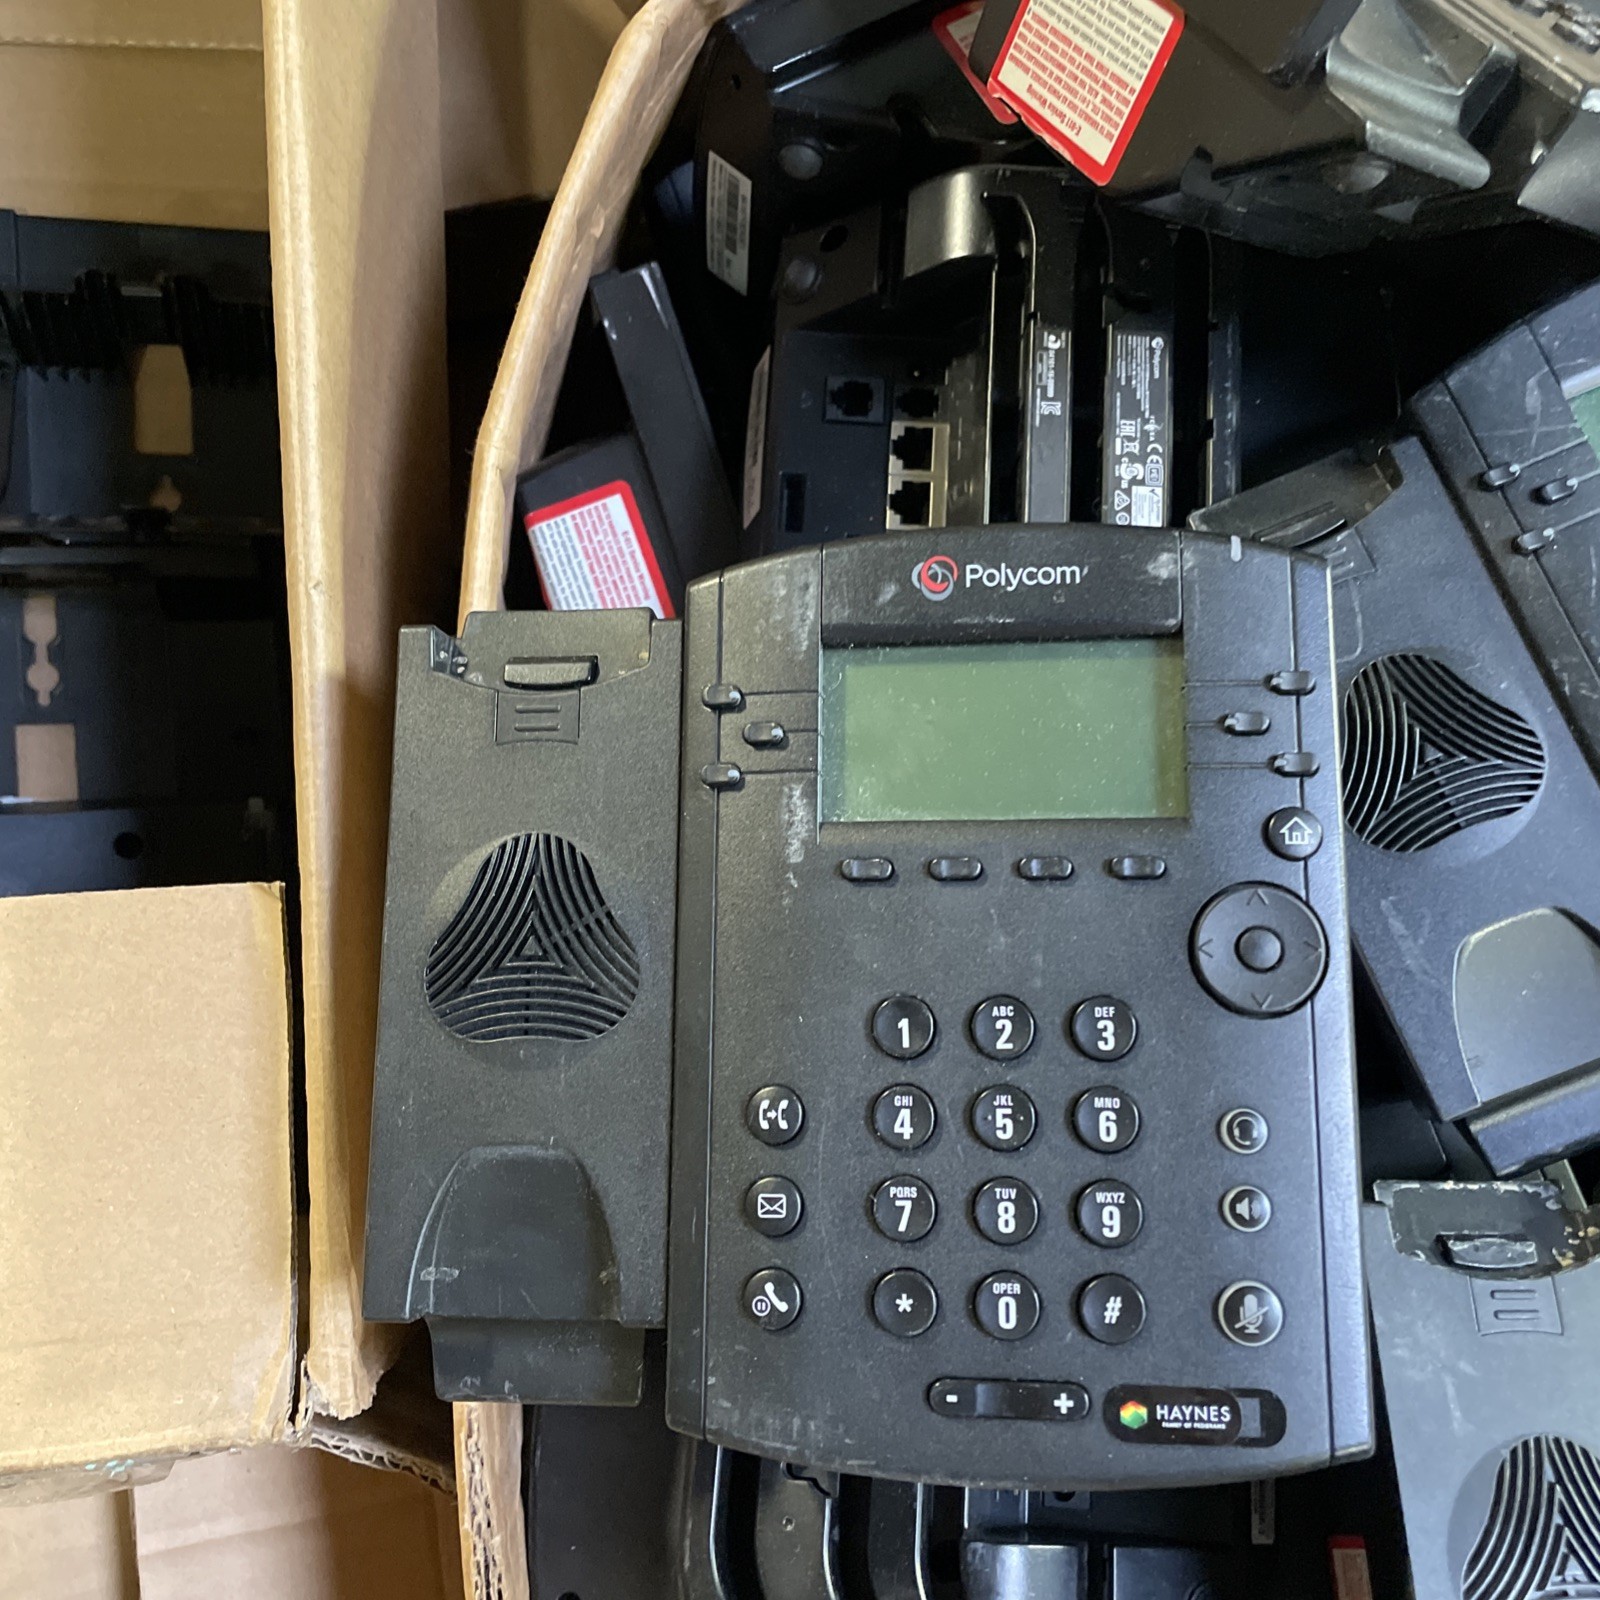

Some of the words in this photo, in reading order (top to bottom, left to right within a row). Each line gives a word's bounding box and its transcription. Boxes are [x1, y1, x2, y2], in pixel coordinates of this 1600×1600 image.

[965, 563, 1081, 592] Polycom
[992, 1005, 1015, 1018] ABC
[1094, 1006, 1116, 1018] DEF
[897, 1018, 910, 1049] 1
[995, 1019, 1014, 1050] 2
[1096, 1019, 1116, 1051] 3
[893, 1095, 913, 1107] GHI
[993, 1095, 1014, 1106] JKL
[1094, 1097, 1121, 1109] MNO
[893, 1108, 914, 1140] 4
[995, 1108, 1014, 1140] 5
[1098, 1110, 1118, 1143] 6
[889, 1186, 918, 1199] PQRS
[994, 1188, 1017, 1200] TUV
[1095, 1192, 1126, 1204] WXYZ
[894, 1200, 913, 1232] 7
[997, 1201, 1016, 1234] 8
[1101, 1205, 1121, 1238] 9
[992, 1282, 1021, 1295] OPER
[998, 1296, 1017, 1330] 0
[1156, 1404, 1231, 1422] HAYNES
